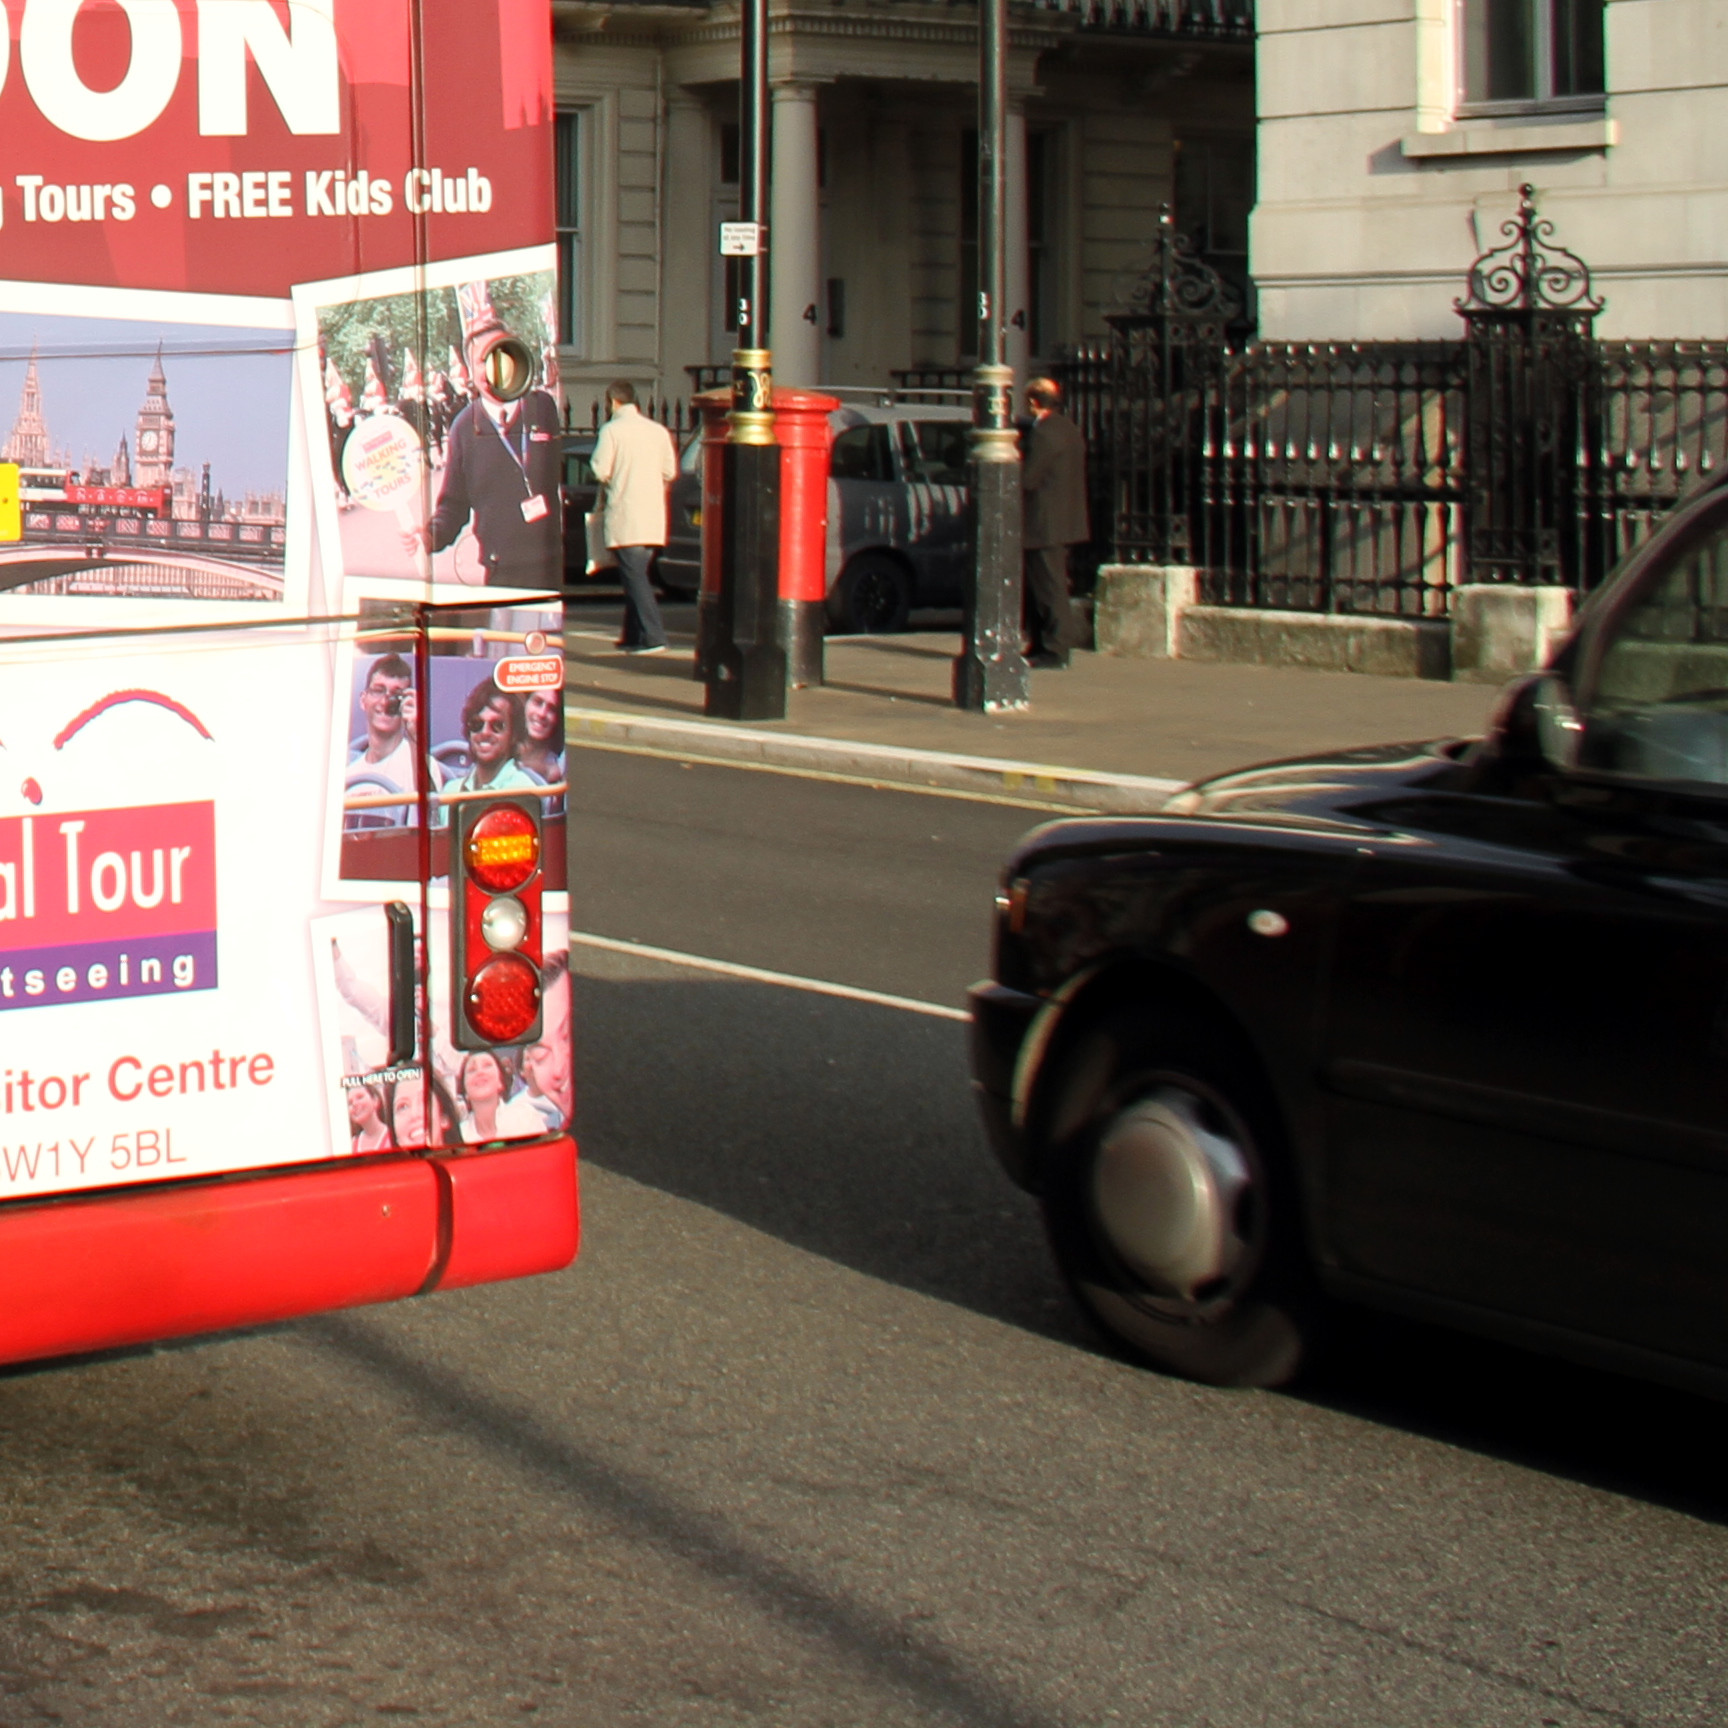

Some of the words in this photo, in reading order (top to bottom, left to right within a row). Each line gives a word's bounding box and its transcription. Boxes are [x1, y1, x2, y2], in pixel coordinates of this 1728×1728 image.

[15, 174, 136, 223] Tours
[187, 173, 292, 220] FREE
[305, 170, 392, 217] Kids
[404, 168, 492, 214] Club
[802, 303, 816, 326] 4
[355, 438, 407, 471] WALKING
[373, 474, 412, 498] TOURS
[506, 674, 539, 685] ENGINE
[540, 673, 558, 683] STOP
[509, 661, 556, 673] EMERGENCY
[58, 820, 192, 916] Tour
[106, 1047, 277, 1106] Centre
[384, 1071, 396, 1082] TO
[110, 1128, 188, 1170] 5BL
